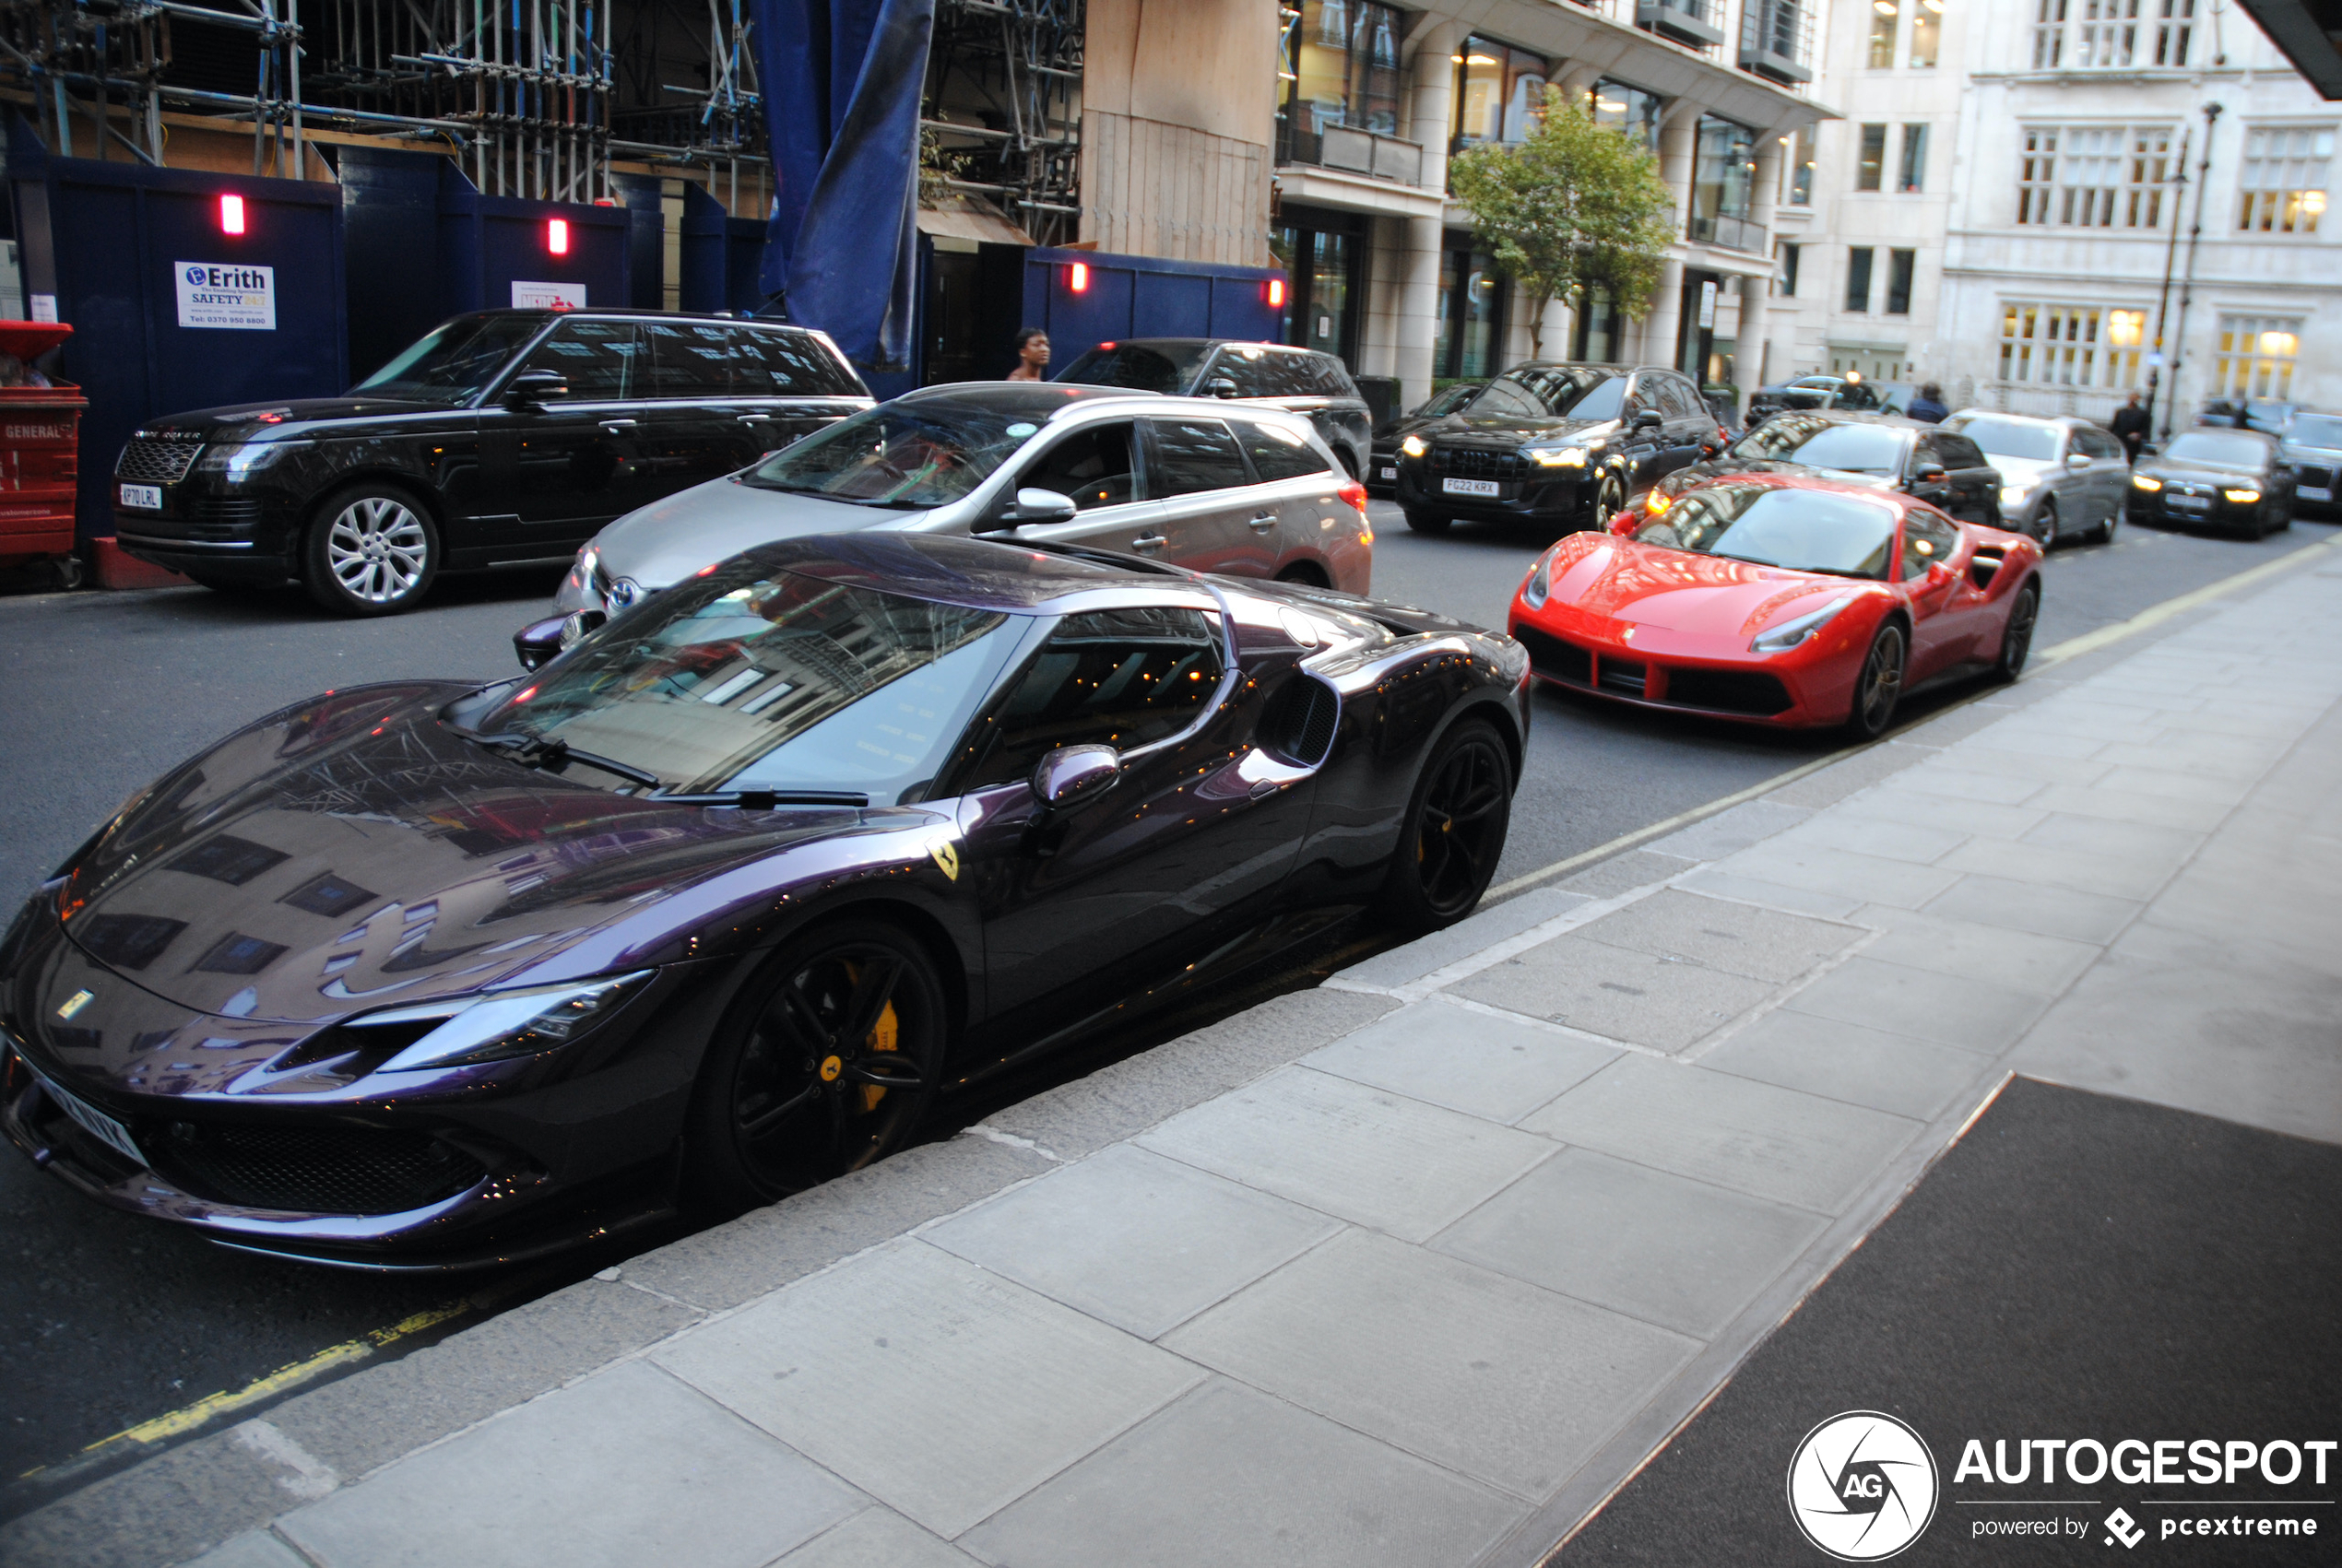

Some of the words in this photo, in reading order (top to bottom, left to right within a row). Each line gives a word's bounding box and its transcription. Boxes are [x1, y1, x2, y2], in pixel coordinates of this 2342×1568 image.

[208, 267, 266, 289] Erith
[192, 293, 243, 305] SAFETY
[6, 424, 61, 438] GENERAL
[1447, 479, 1472, 491] FG22
[1473, 482, 1494, 493] KRX
[141, 489, 157, 506] LRL
